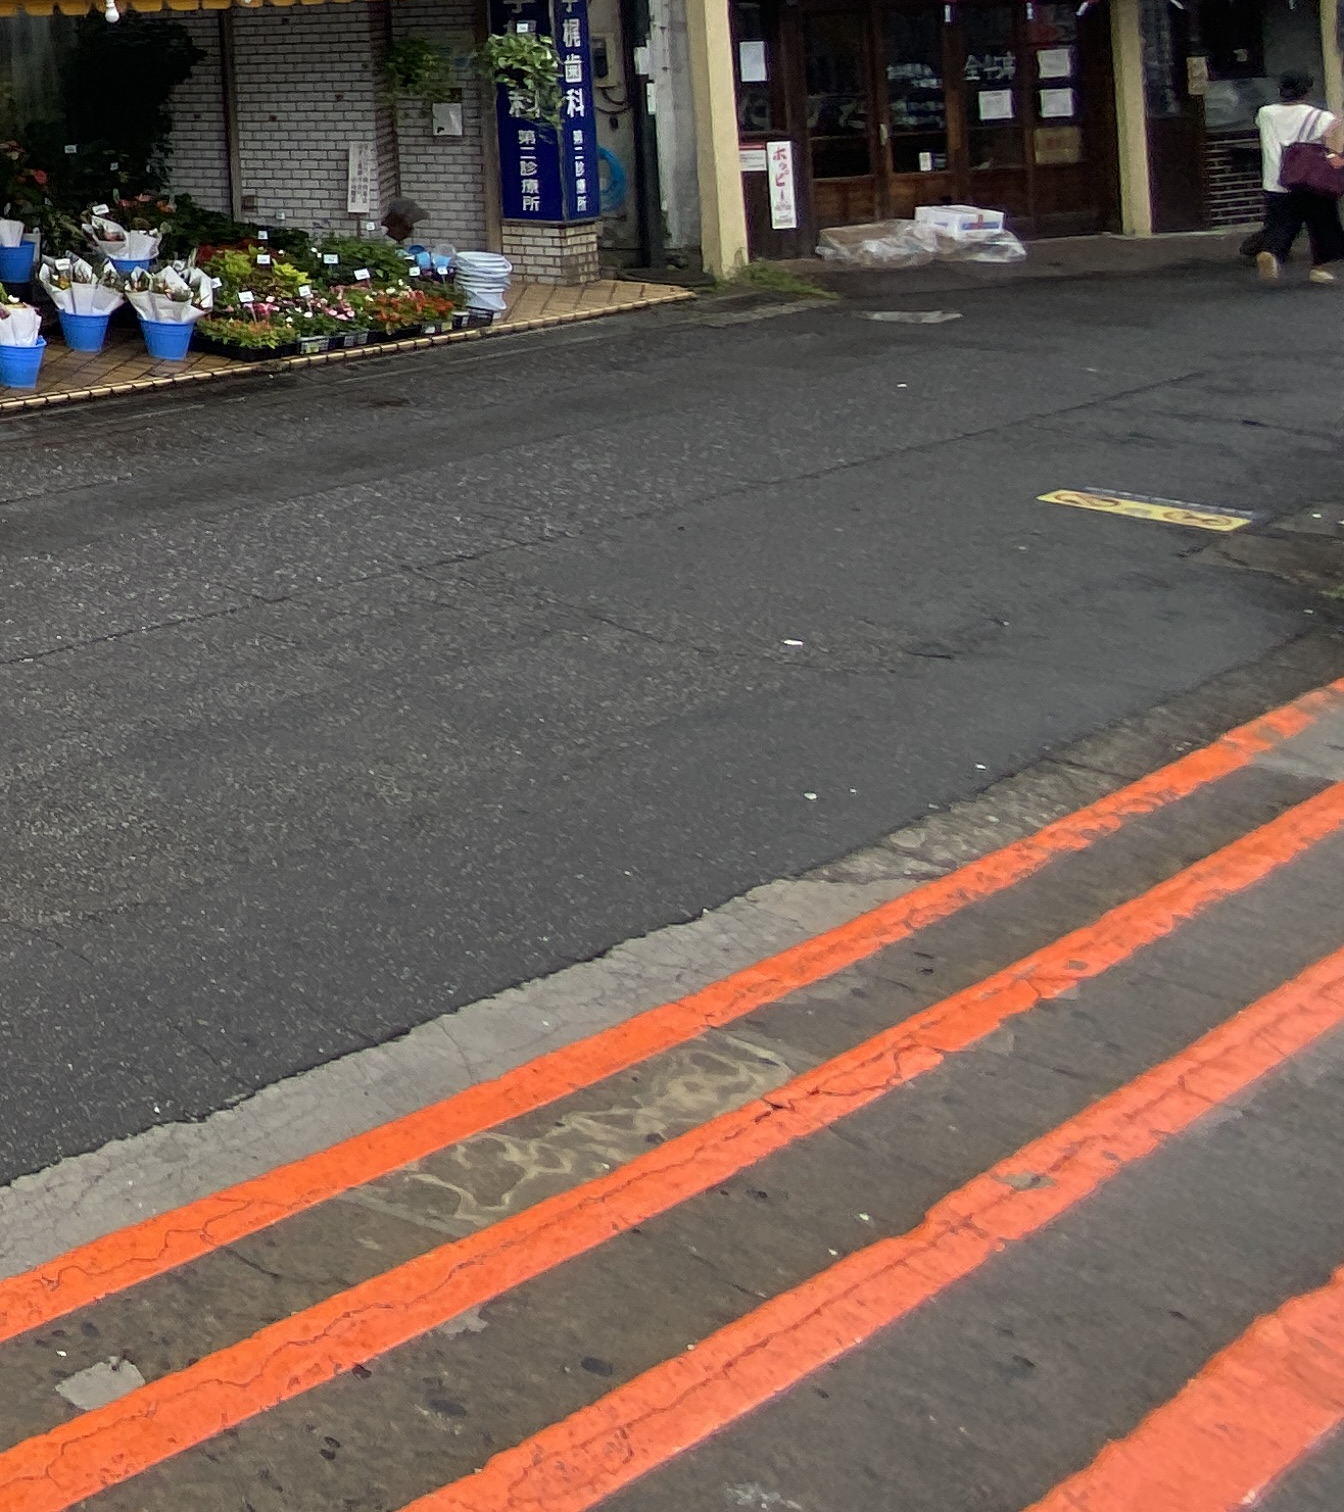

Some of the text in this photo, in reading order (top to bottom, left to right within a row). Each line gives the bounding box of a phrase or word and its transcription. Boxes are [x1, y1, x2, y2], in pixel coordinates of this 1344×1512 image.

[518, 130, 541, 212] 第二診療所
